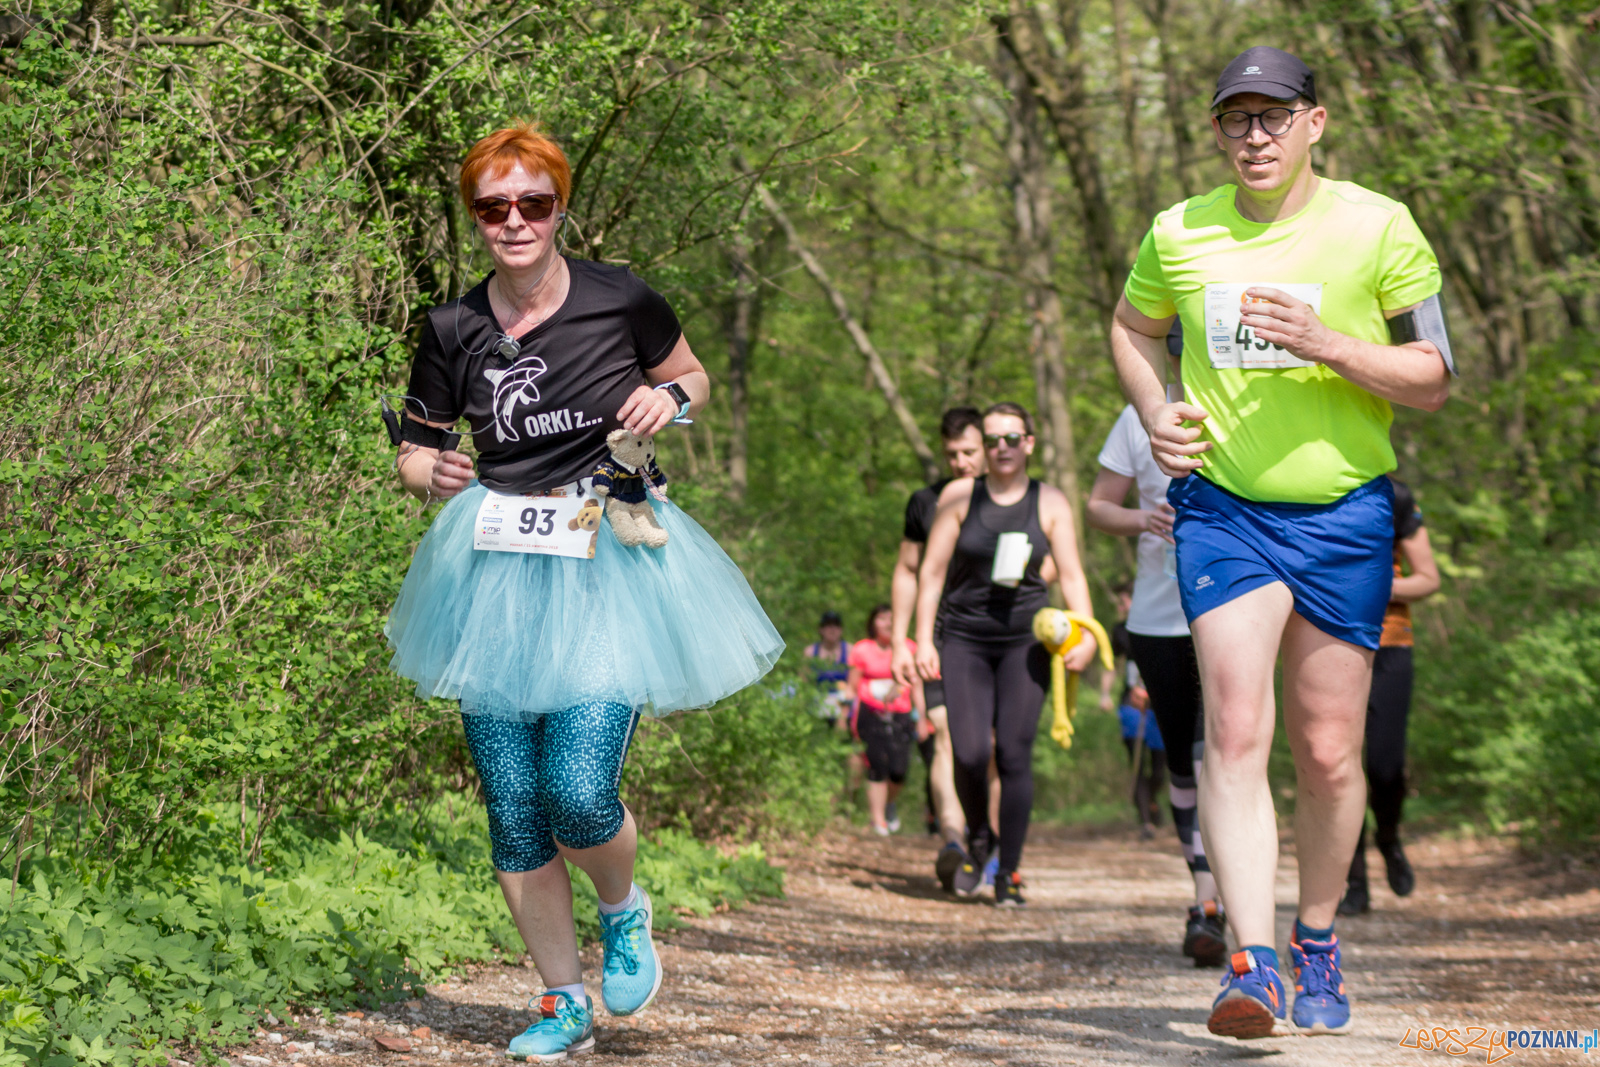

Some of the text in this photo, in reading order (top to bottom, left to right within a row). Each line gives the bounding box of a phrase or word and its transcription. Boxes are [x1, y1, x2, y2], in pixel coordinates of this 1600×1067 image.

[1235, 320, 1286, 351] 45
[524, 408, 573, 438] ORKI
[518, 507, 557, 536] 93
